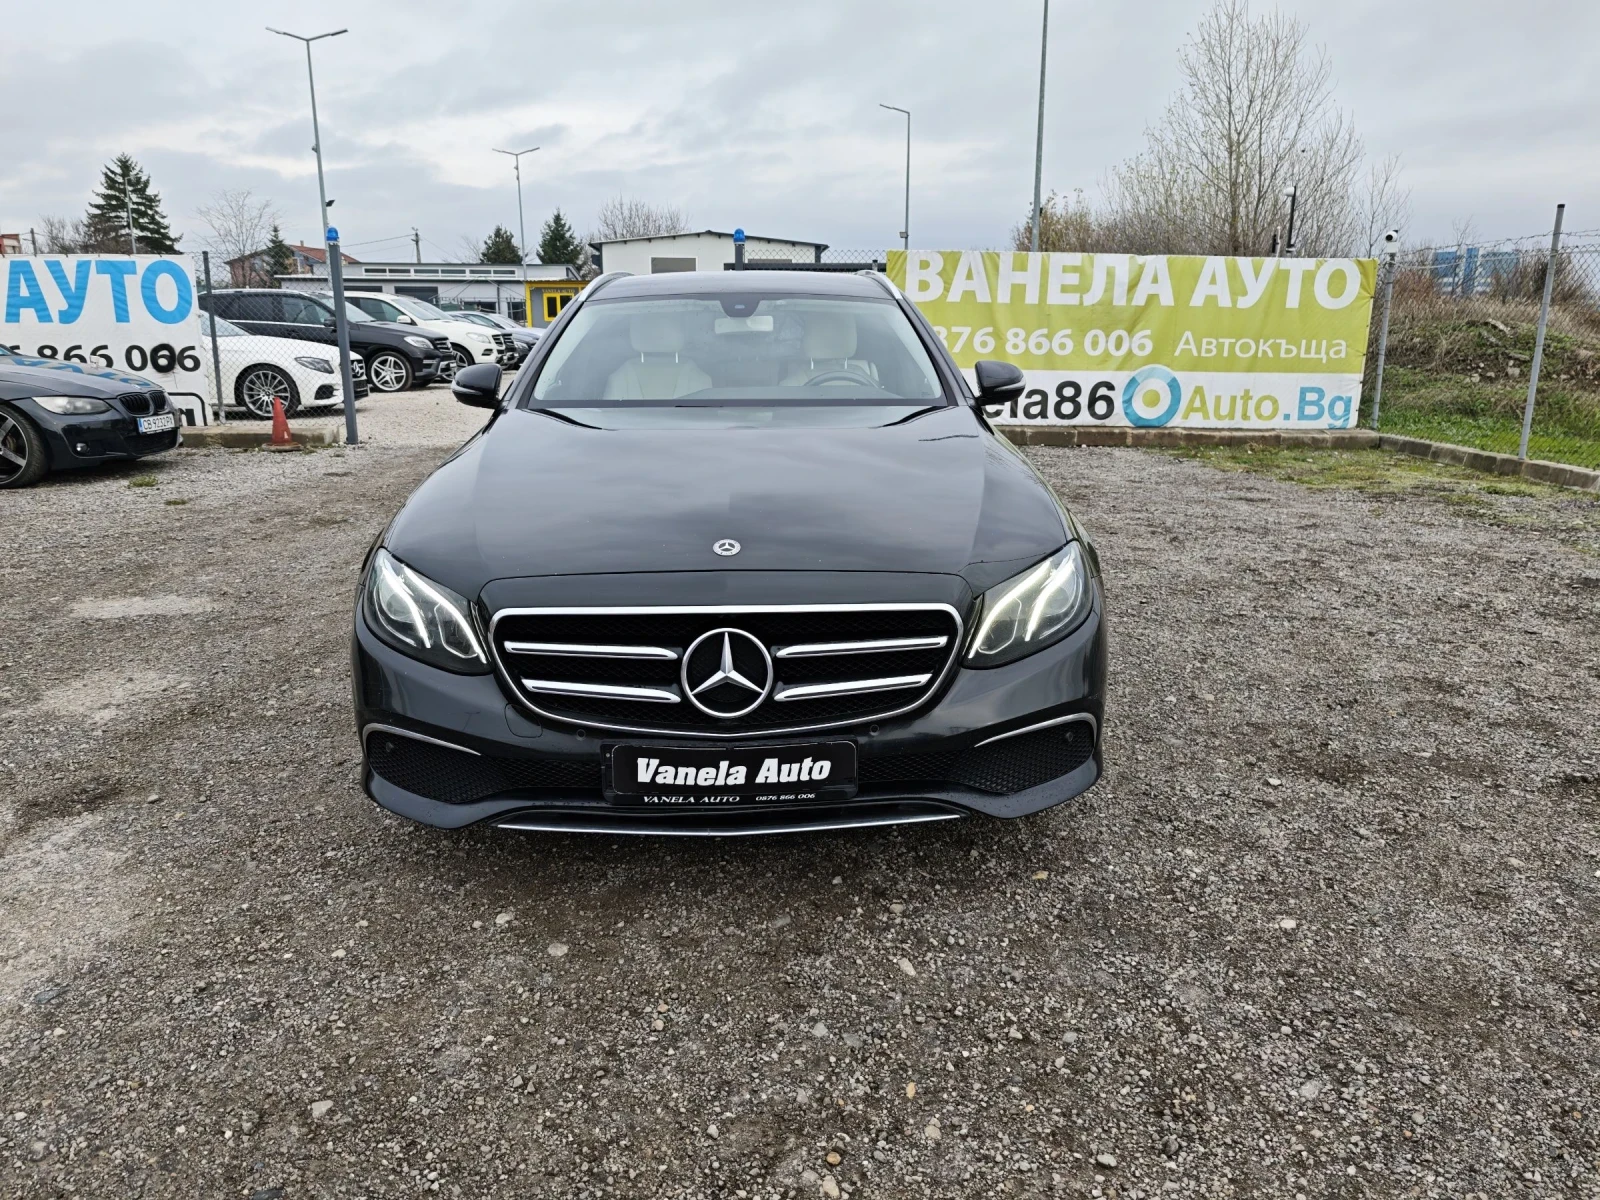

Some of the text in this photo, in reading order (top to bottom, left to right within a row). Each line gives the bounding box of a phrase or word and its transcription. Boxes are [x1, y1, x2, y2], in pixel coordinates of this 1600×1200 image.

[5, 260, 192, 324] АУТО
[905, 250, 1361, 310] ВАНЕЛА АУТО
[1005, 327, 1074, 355] 866
[1084, 328, 1153, 357] 006
[1174, 331, 1347, 364] Автокъща
[637, 756, 832, 786] Vanela Auto
[643, 795, 695, 803] VANELA
[700, 795, 740, 803] AUTO
